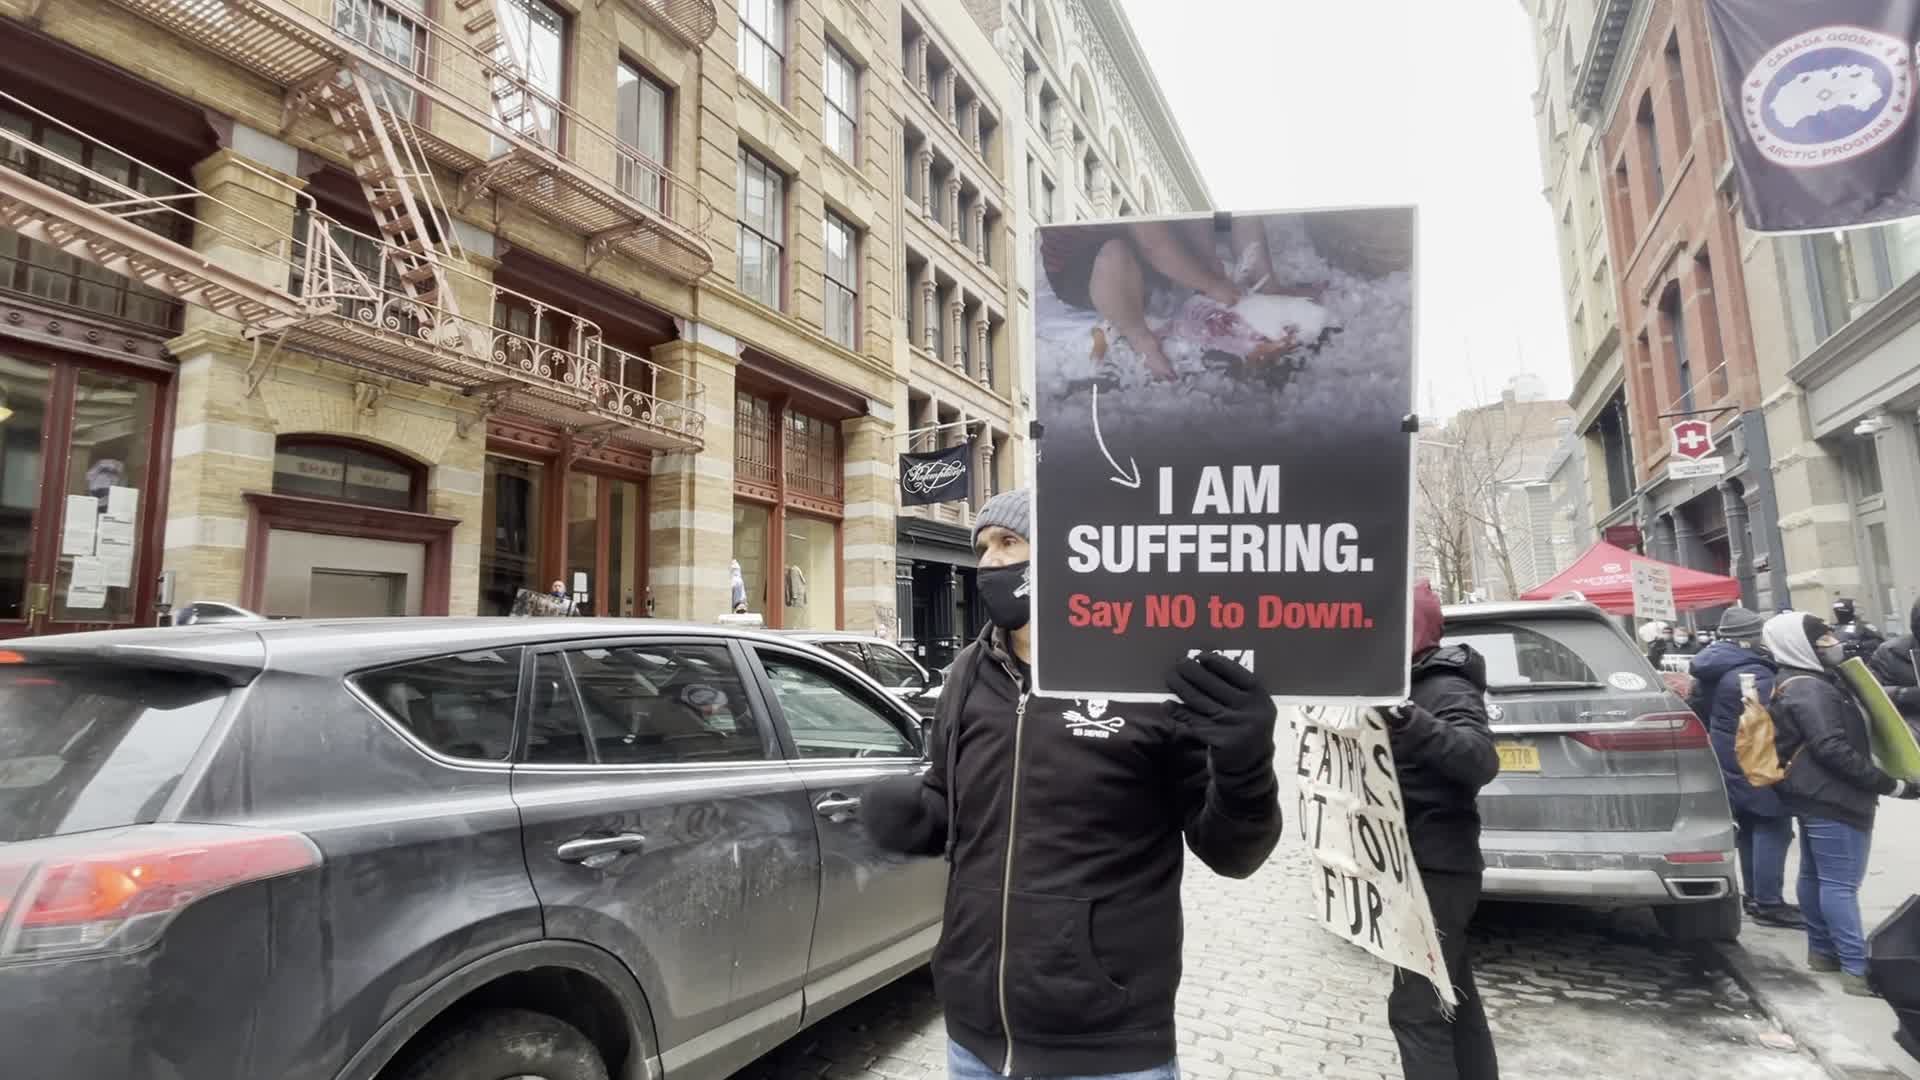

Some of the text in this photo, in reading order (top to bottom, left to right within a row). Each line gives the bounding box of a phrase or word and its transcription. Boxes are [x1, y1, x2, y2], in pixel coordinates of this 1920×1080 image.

[1767, 33, 1873, 68] CANADA GOOSE
[1767, 118, 1893, 160] ARCTIC PROGRAM
[1159, 464, 1280, 515] I AM
[1067, 522, 1375, 573] SUFFERING.
[1068, 593, 1374, 635] Say NO to Down.
